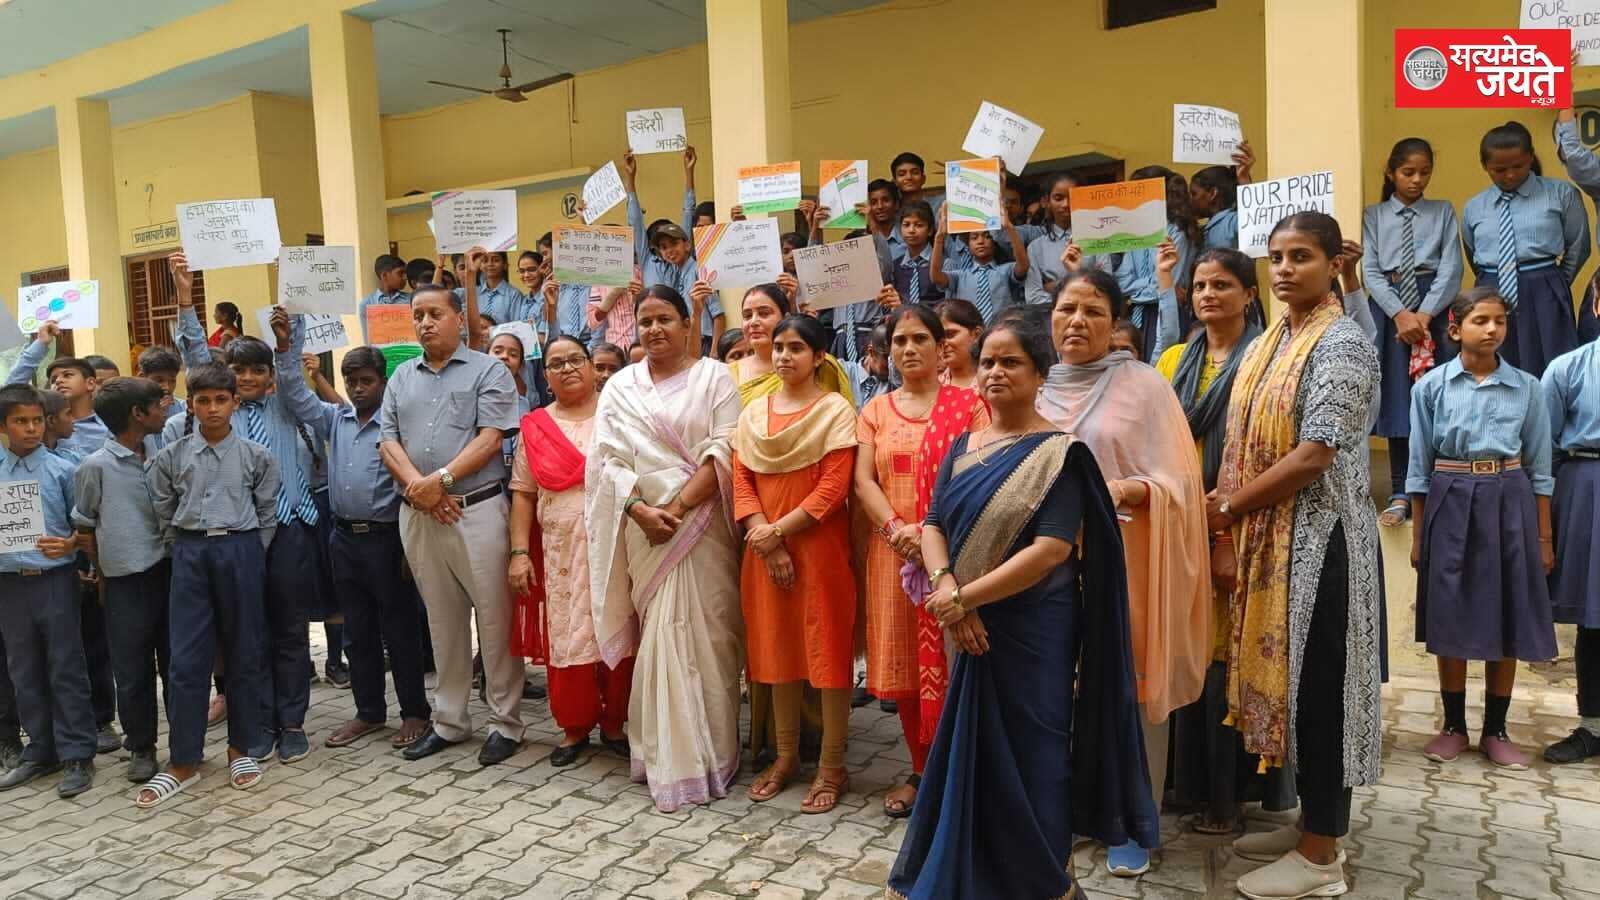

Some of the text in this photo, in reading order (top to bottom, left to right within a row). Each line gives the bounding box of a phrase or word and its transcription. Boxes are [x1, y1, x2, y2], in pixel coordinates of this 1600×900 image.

[1529, 0, 1568, 20] OUR
[1558, 12, 1600, 28] PRIDE
[1242, 172, 1334, 209] OUR PRIDE
[564, 196, 577, 217] 12
